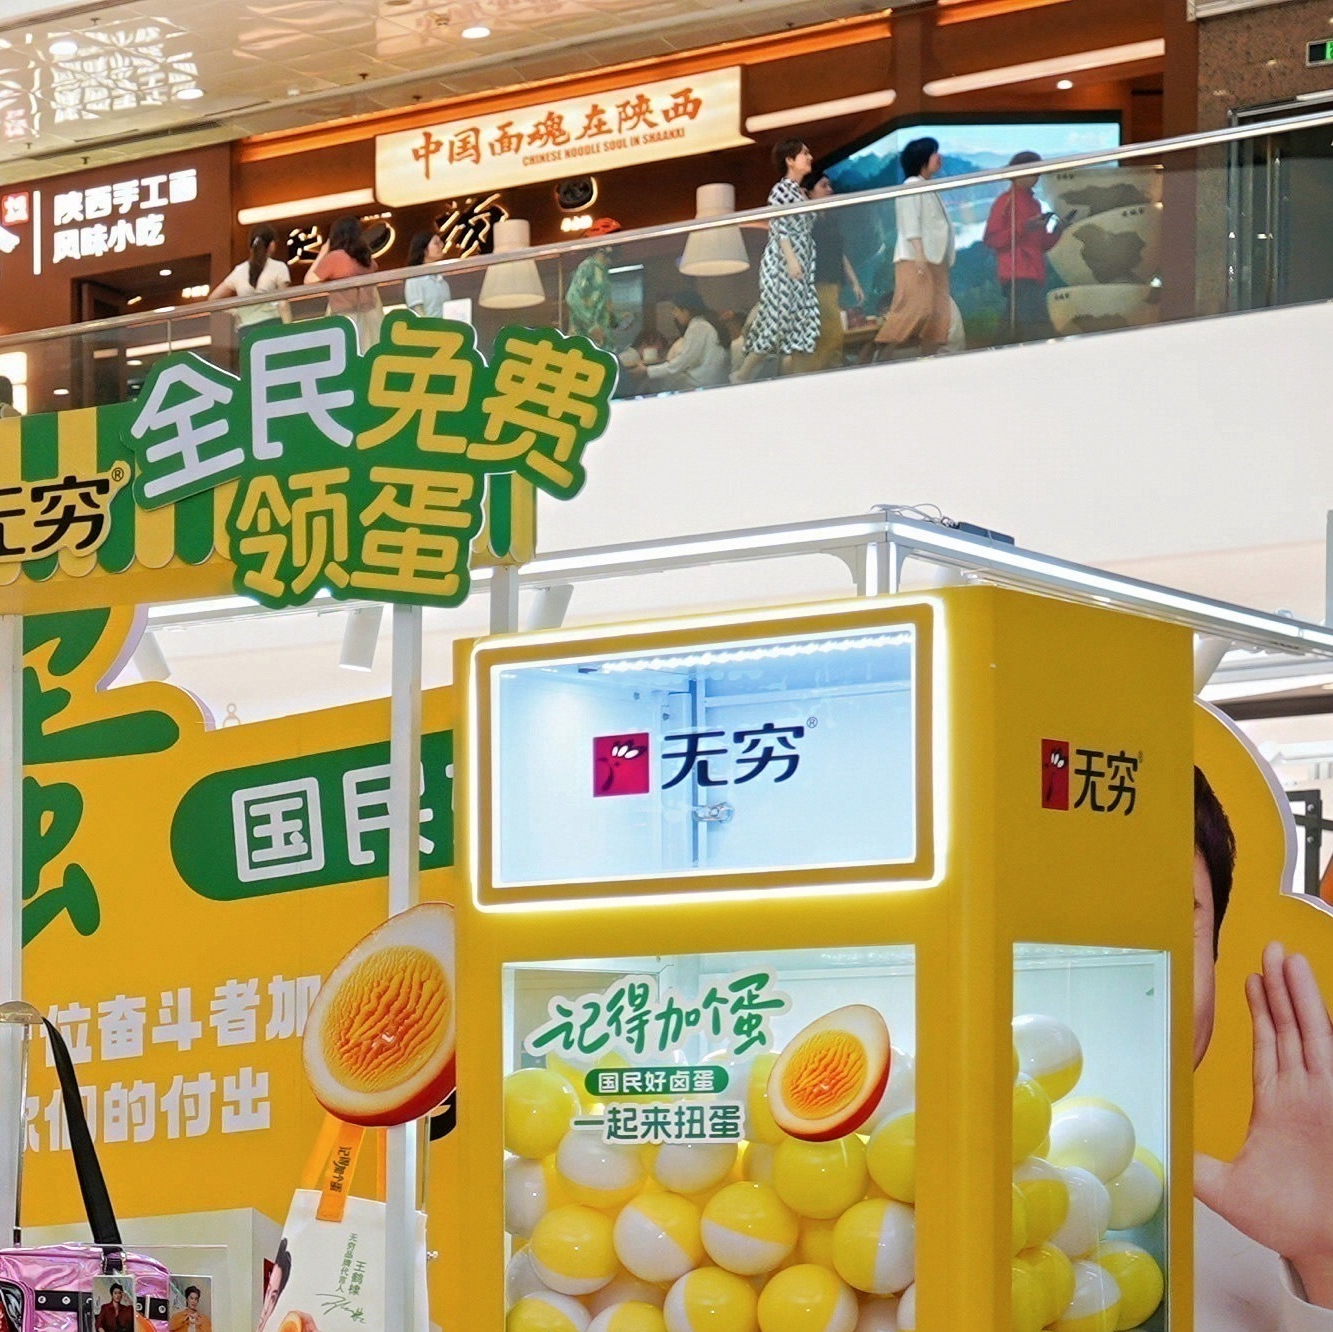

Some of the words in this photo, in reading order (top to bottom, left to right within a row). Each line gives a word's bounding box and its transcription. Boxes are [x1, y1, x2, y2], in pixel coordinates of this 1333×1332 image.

[522, 150, 562, 167] CHINESE
[565, 144, 601, 161] NOODLE
[603, 139, 628, 155] SOUL
[630, 136, 640, 149] IN
[52, 213, 166, 264] 风味小吃
[132, 322, 607, 502] 全民免费
[235, 467, 475, 593] 领蛋
[660, 722, 806, 790] 无穷
[1073, 750, 1138, 816] 无穷
[231, 760, 454, 884] 国民
[534, 972, 785, 1053] 记得加个蛋
[597, 1069, 715, 1096] 国民好卤蛋
[573, 1105, 741, 1142] 一起来扭蛋
